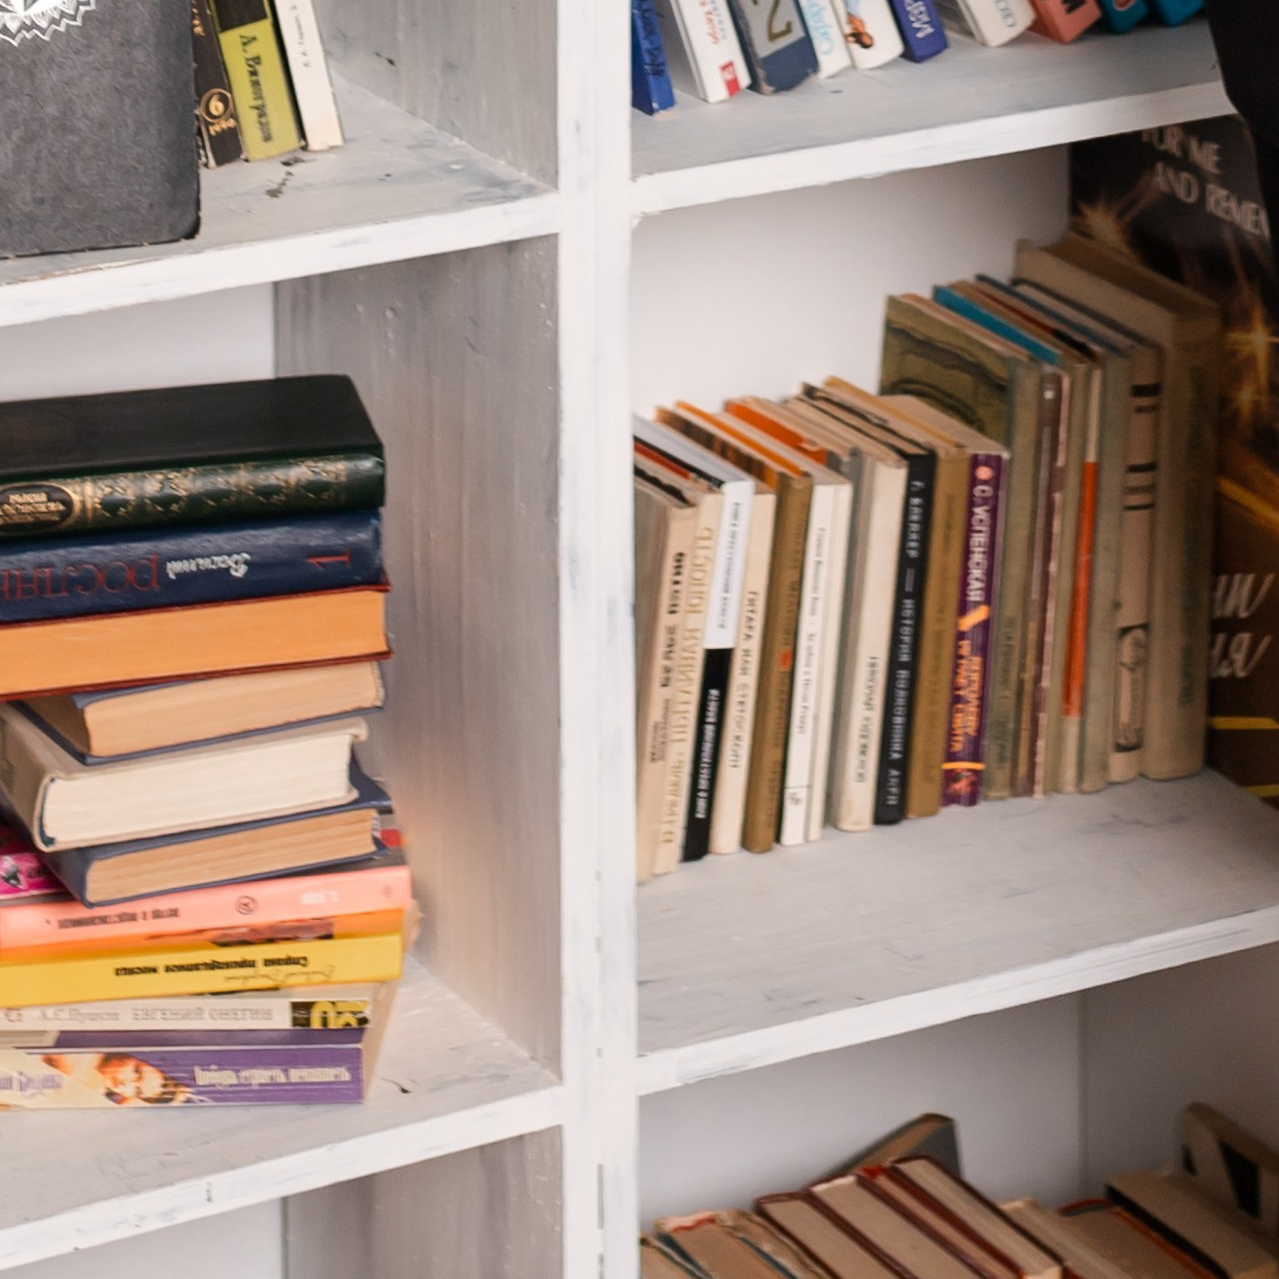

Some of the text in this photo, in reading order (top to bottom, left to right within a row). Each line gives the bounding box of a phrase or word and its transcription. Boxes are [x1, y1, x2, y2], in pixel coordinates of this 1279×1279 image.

[208, 93, 226, 117] 6
[167, 550, 252, 581] Василий
[967, 505, 993, 604] УСПЕНСКАЯ
[742, 591, 759, 643] ГИТАРА
[898, 598, 915, 662] ИСТОРИЯ
[132, 1004, 205, 1024] ЕВГЕНИЙ
